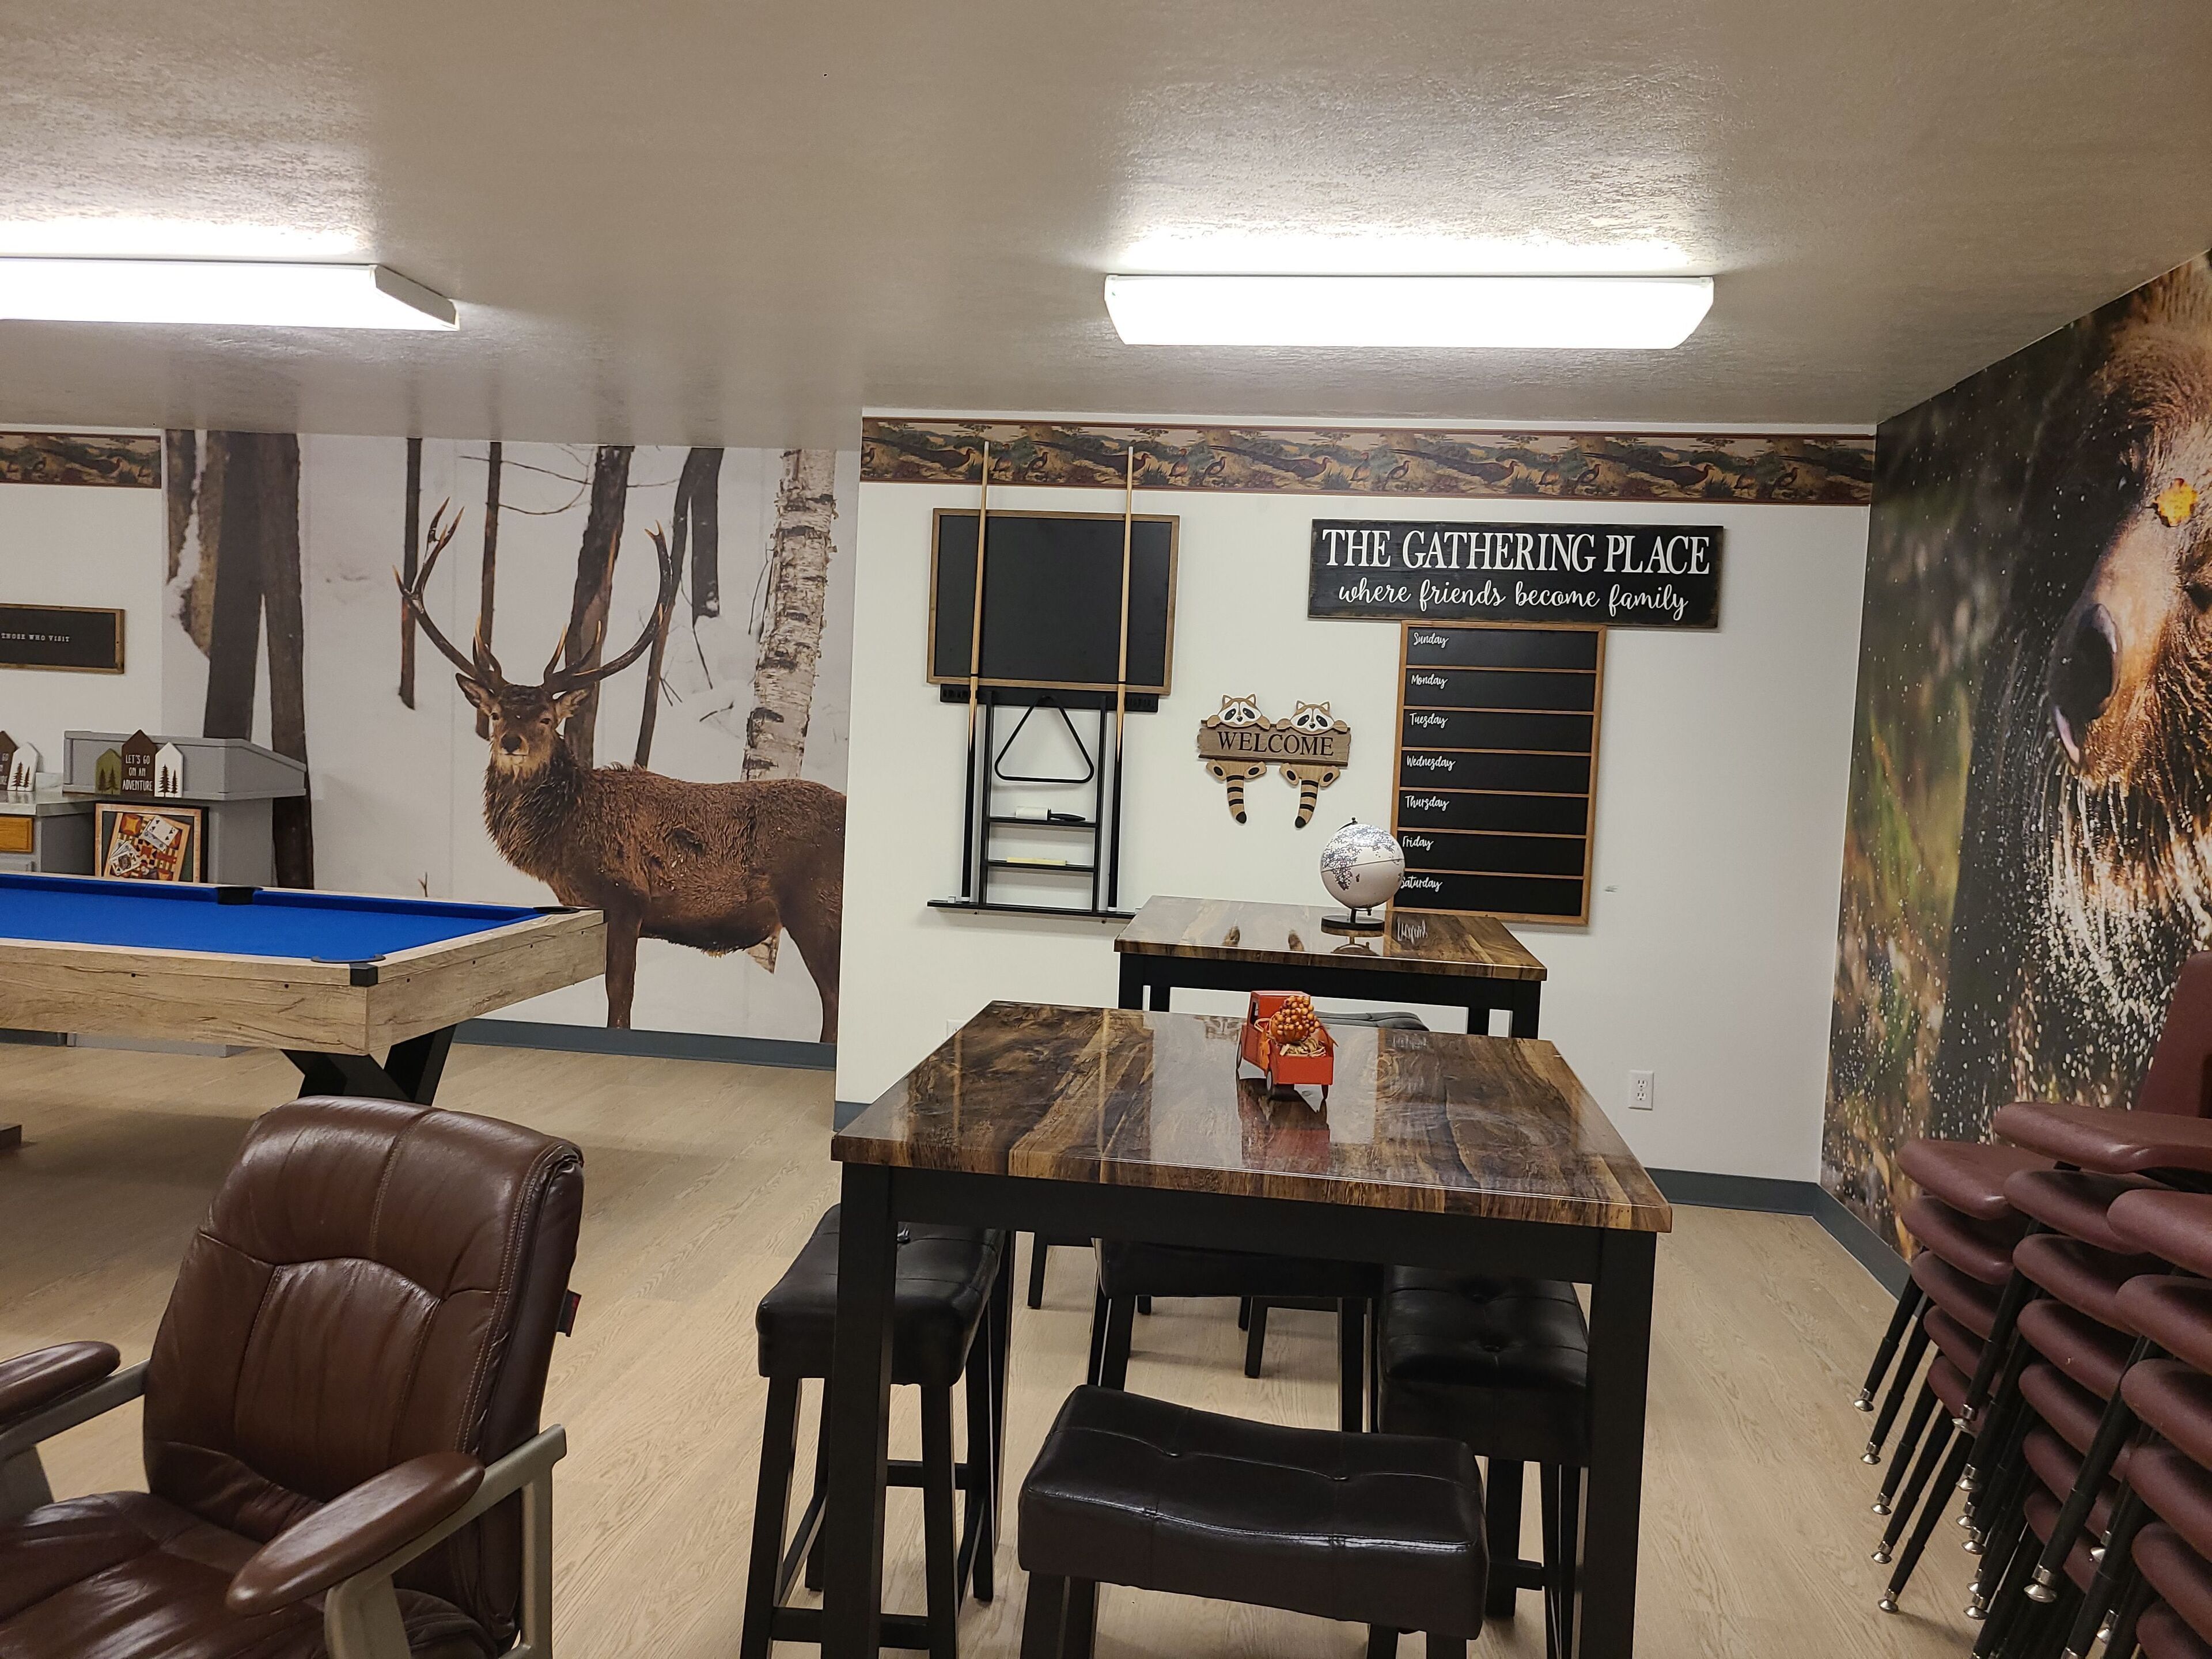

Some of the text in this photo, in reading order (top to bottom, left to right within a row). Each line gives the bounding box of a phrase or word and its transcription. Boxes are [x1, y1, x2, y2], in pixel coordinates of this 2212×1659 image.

[1323, 529, 1709, 574] THE GATHERING PLACE
[1339, 578, 1688, 620] where friends become family
[1414, 632, 1449, 648] Sunday
[1411, 674, 1448, 689] Monday
[1410, 713, 1448, 728] Tuesday
[1217, 731, 1334, 756] WELCOME
[126, 755, 150, 764] LET'S GO
[1407, 756, 1456, 771] Wednesday
[128, 767, 136, 777] ON
[122, 779, 153, 791] ADVENTURE
[1405, 796, 1449, 811] Thursday
[1403, 836, 1434, 851] Friday
